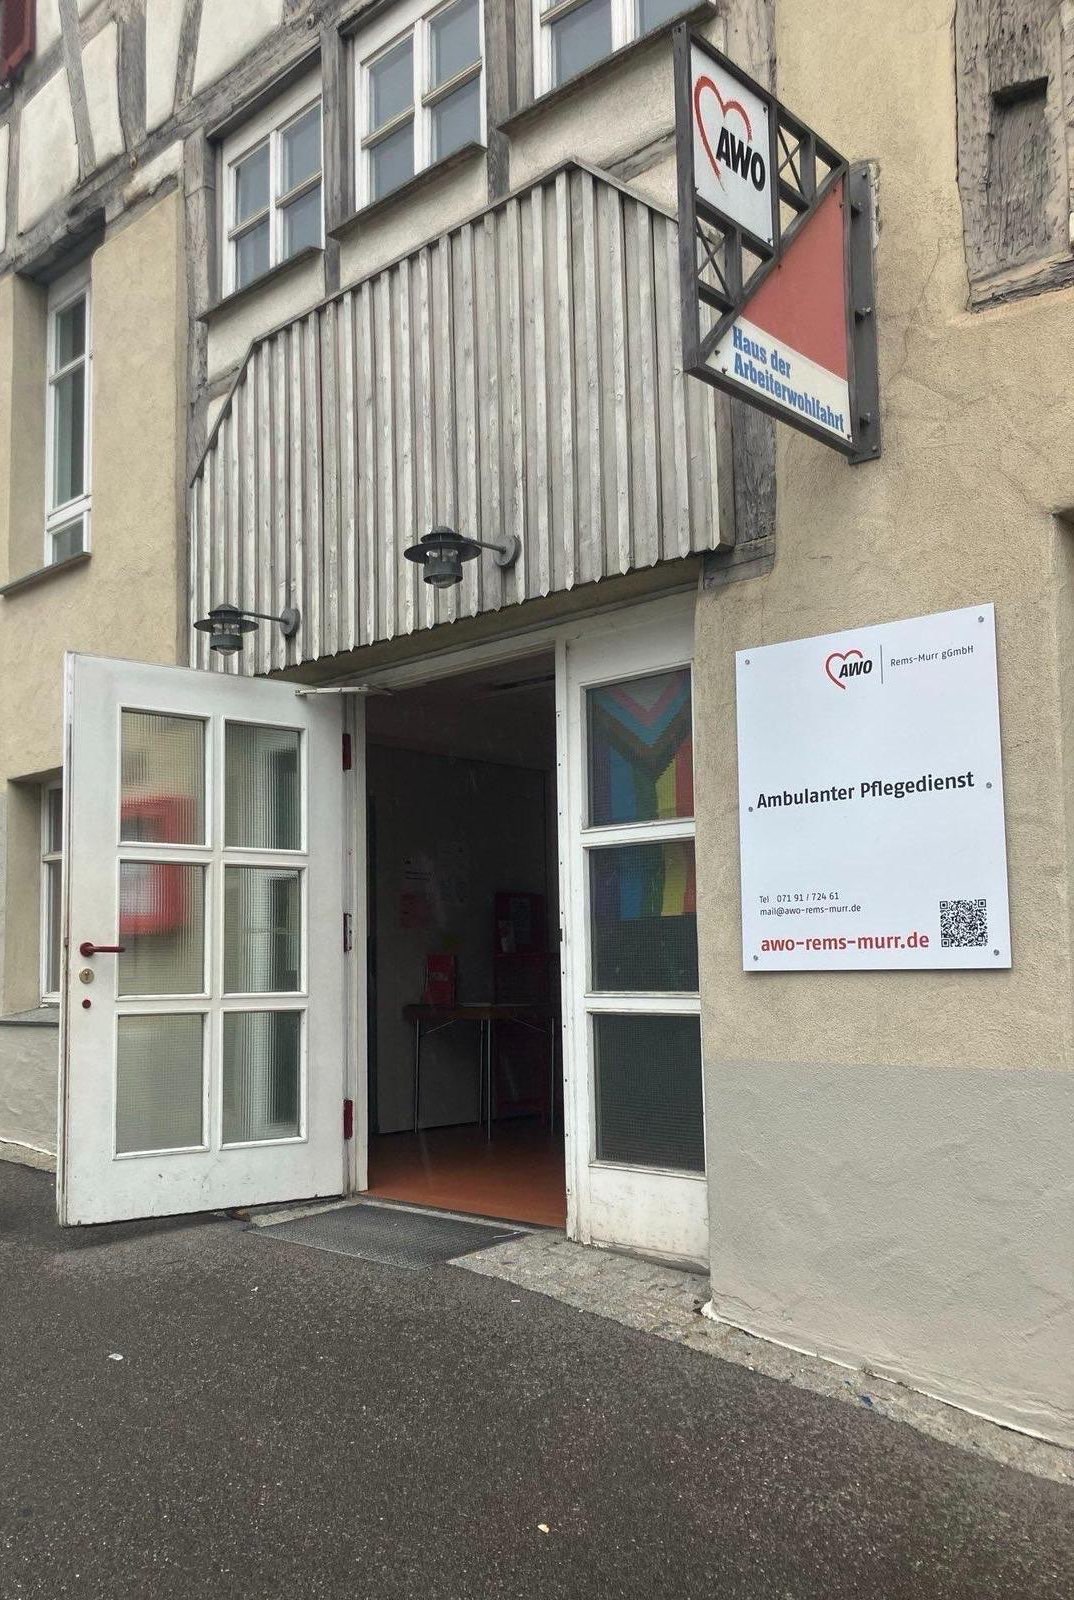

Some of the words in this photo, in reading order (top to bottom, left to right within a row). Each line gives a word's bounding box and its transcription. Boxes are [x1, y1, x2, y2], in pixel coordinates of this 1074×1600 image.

[716, 126, 766, 192] AWO
[732, 324, 767, 365] Haus
[770, 348, 791, 379] der
[734, 352, 844, 433] Arbeiterwohlfahrt
[890, 653, 939, 667] Rems-Murr
[941, 645, 974, 660] gGmbH
[839, 660, 873, 679] AWO
[757, 784, 855, 809] Ambulanter
[860, 771, 975, 799] Pflegedienst
[759, 895, 770, 904] Tel
[776, 894, 792, 903] 071
[794, 893, 804, 902] 91
[811, 892, 827, 901] 724
[829, 891, 840, 900] 61
[760, 904, 861, 917] mail@awo-rems-murr.de
[761, 931, 930, 952] awo-rems-murr.de
